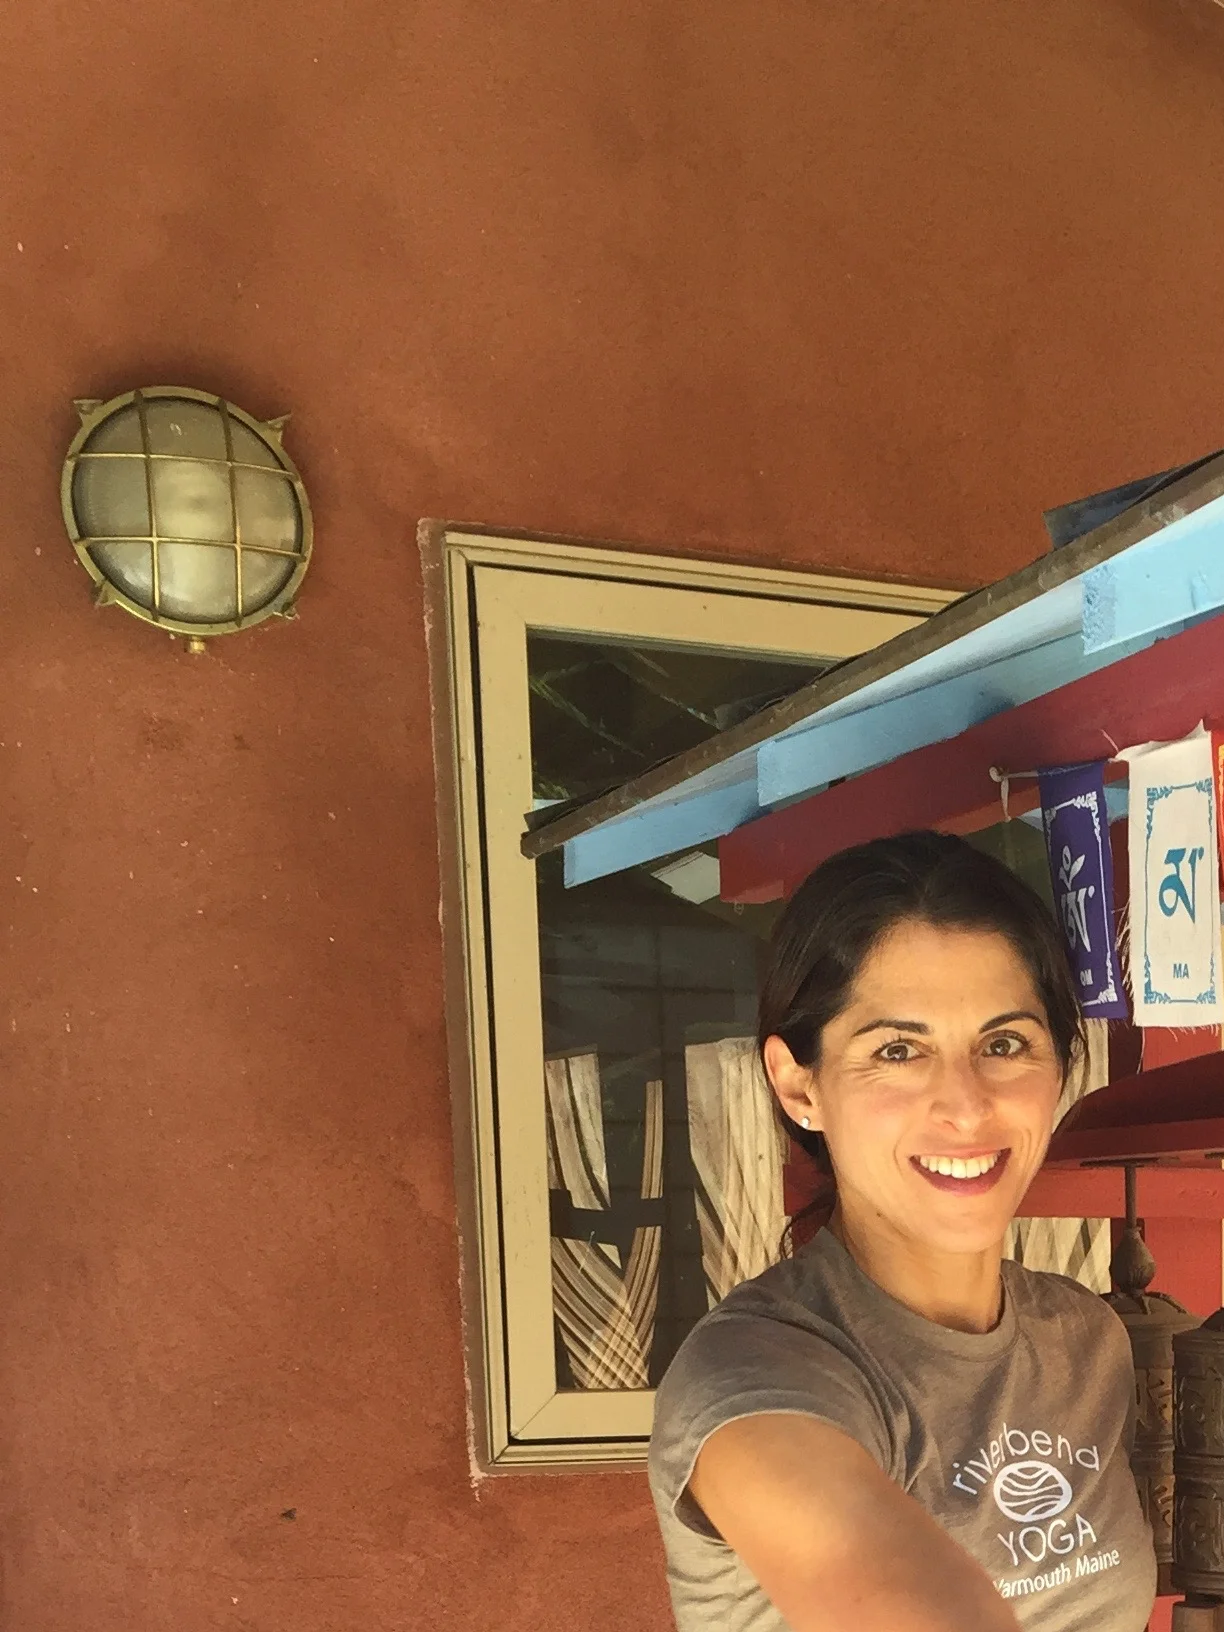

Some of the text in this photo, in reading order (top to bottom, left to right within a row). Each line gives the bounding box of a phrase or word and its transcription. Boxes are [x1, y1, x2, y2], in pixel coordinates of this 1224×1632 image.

[1079, 968, 1094, 987] OM
[1172, 963, 1190, 980] MA
[952, 1422, 1100, 1495] riverbend
[997, 1513, 1097, 1566] YOGA
[1075, 1549, 1121, 1578] Maine
